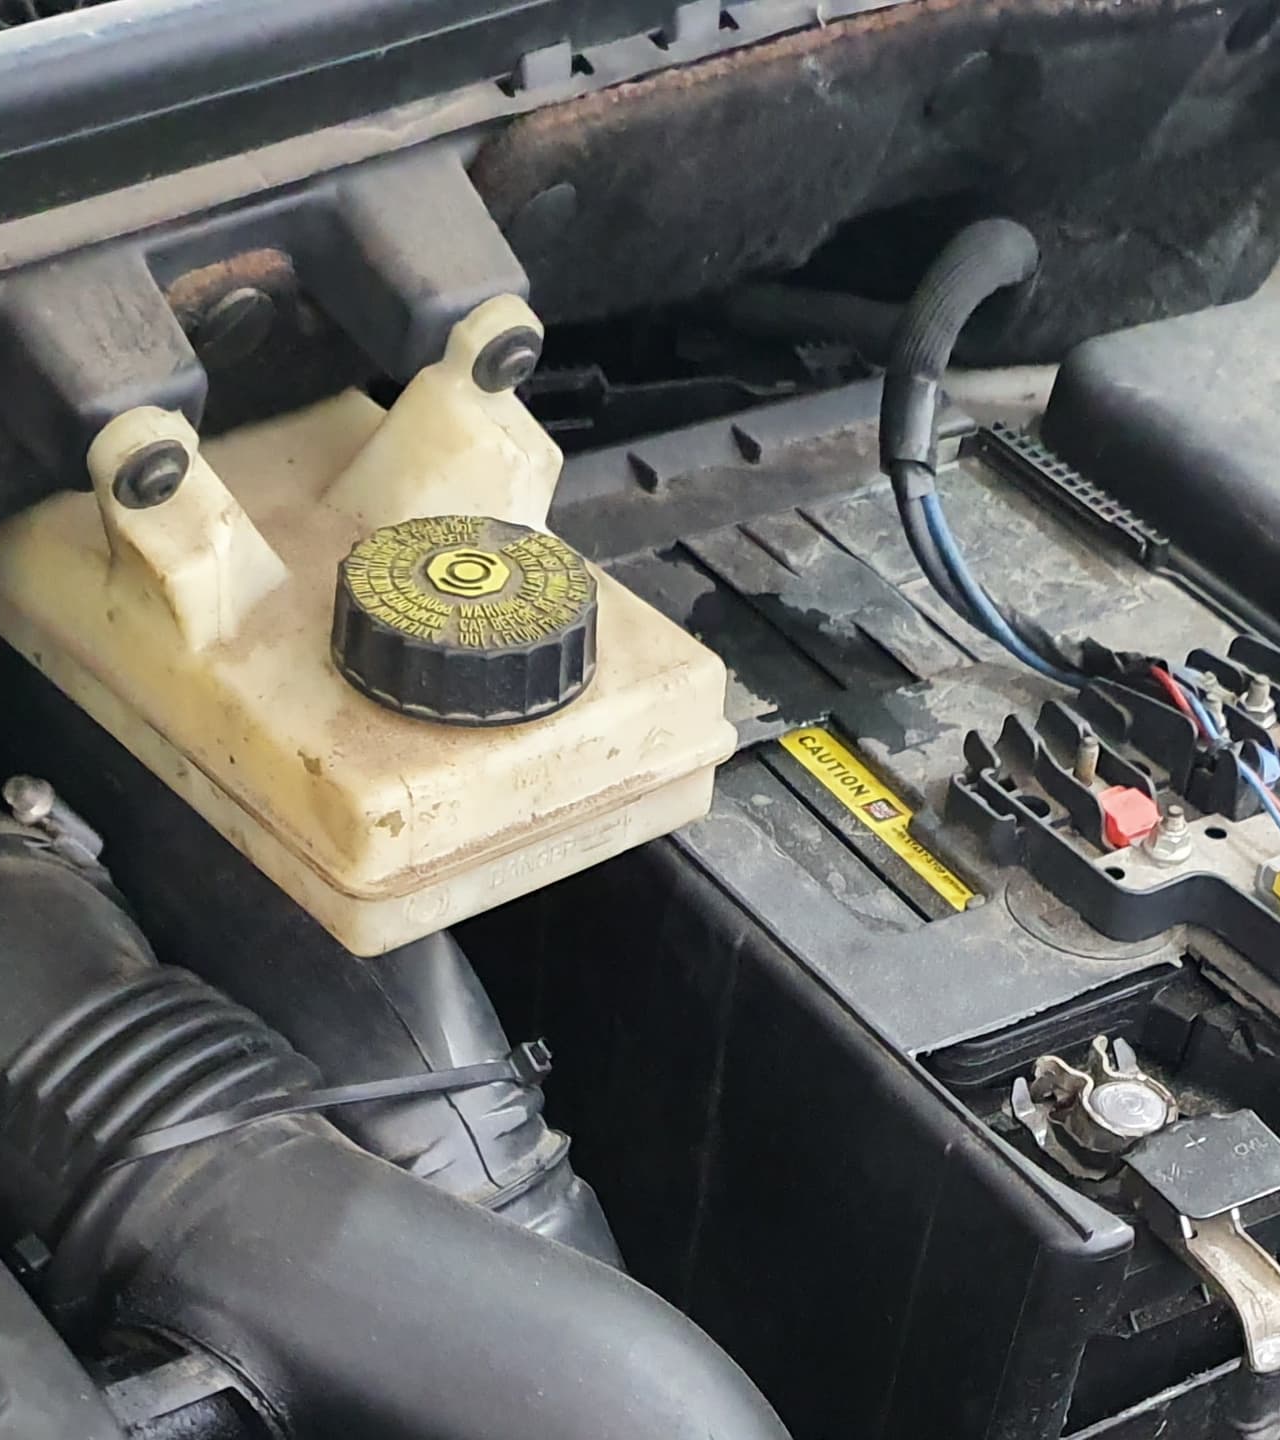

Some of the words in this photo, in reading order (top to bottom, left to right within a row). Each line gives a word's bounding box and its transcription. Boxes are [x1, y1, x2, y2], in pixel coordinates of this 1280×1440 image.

[460, 597, 526, 618] WARNING
[460, 618, 487, 634] CAP
[798, 735, 871, 798] CAUTION
